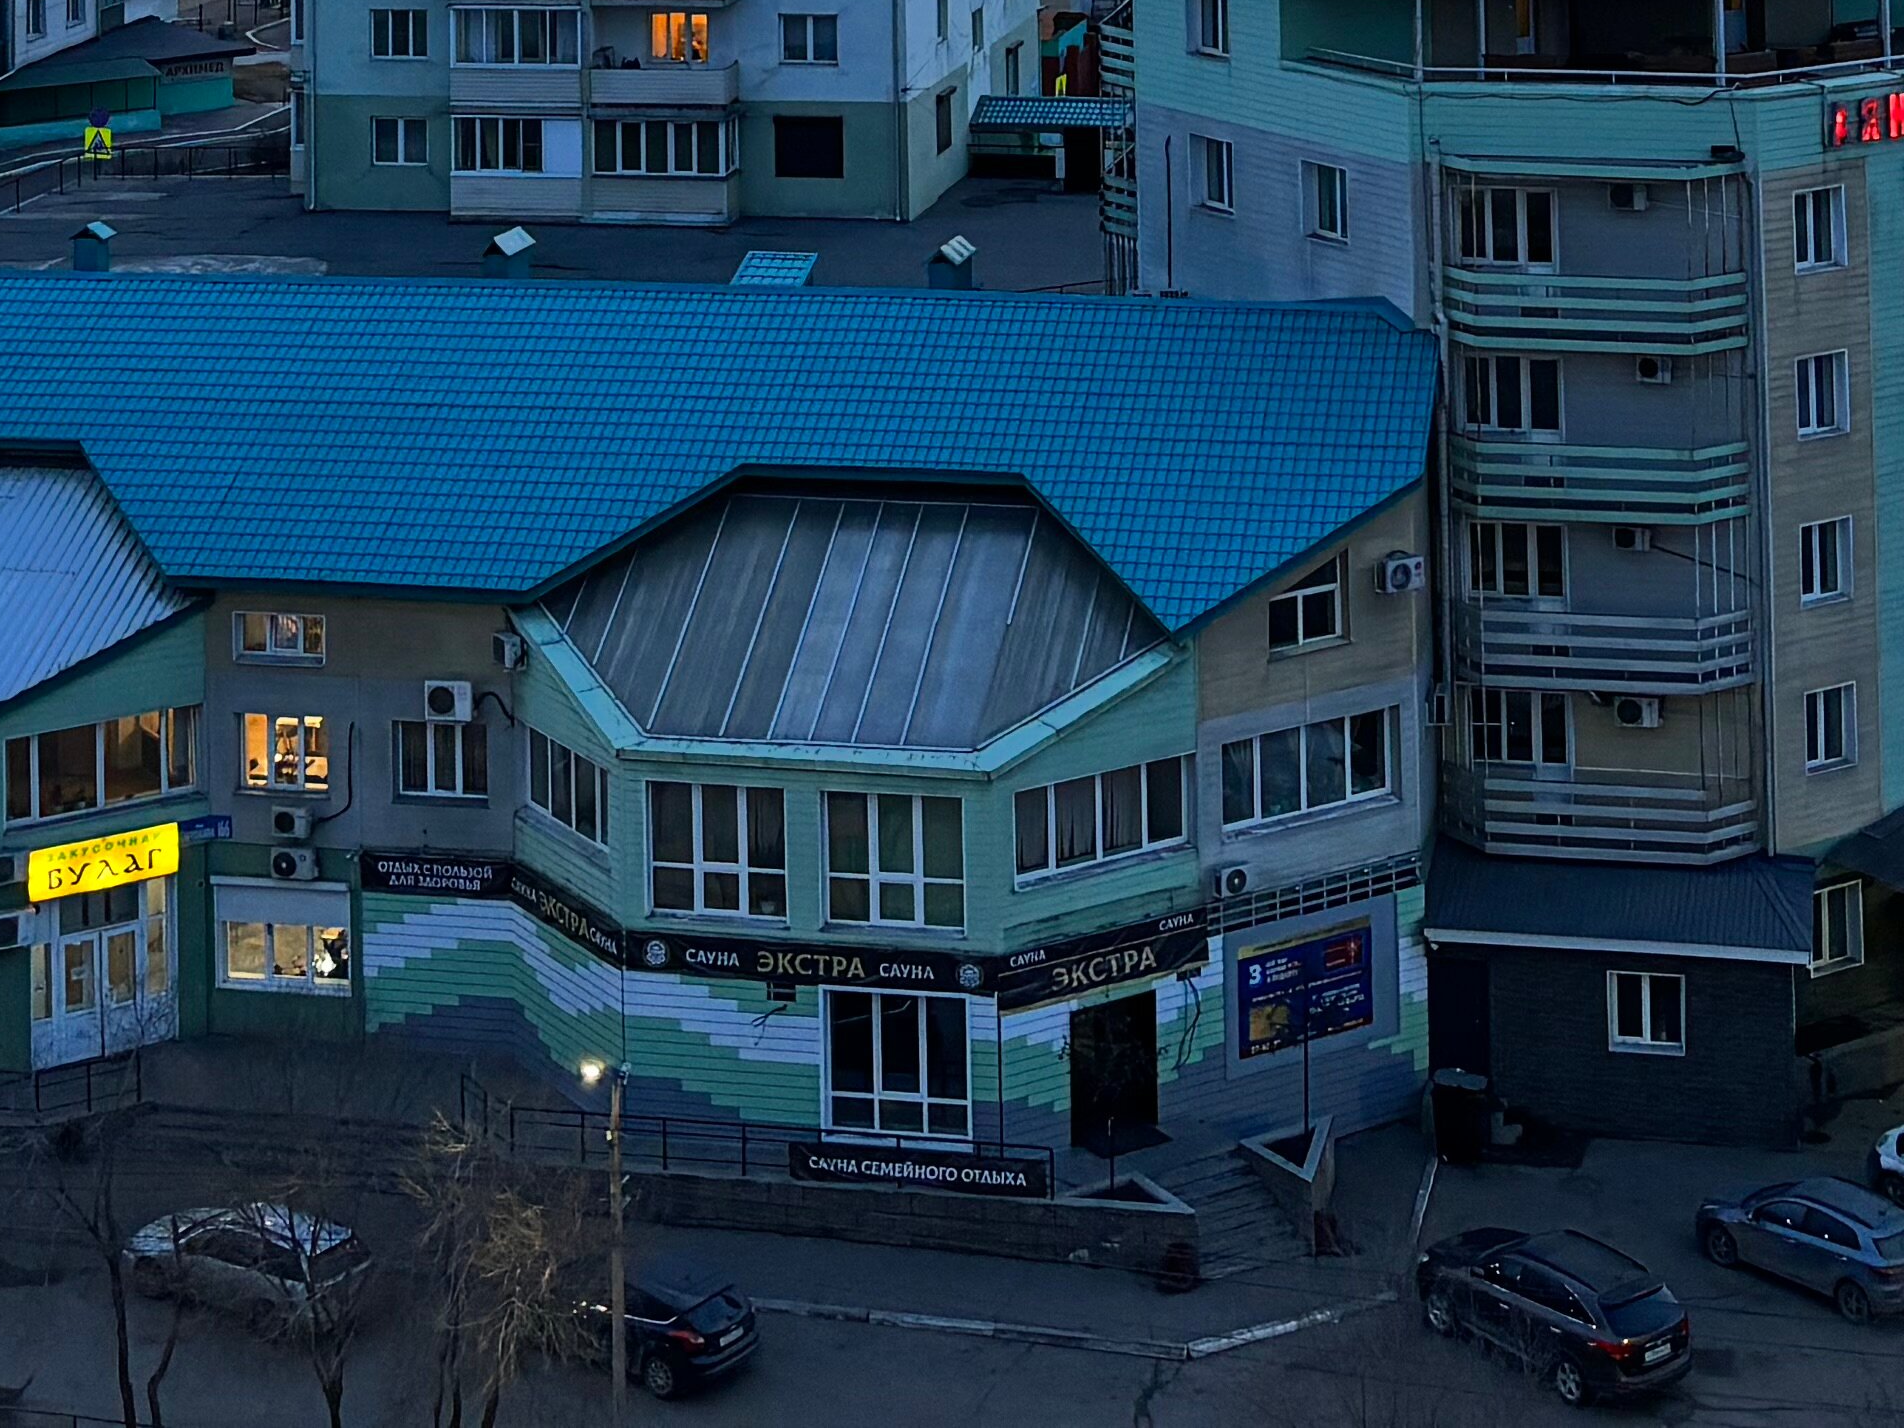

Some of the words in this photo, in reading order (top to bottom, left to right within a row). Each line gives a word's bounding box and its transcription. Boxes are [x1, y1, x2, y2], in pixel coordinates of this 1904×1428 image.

[377, 860, 421, 874] ОТДЫХ
[423, 863, 431, 875] С
[433, 863, 494, 880] ПОЛЬЗОЙ
[388, 874, 415, 887] ДЛЯ
[417, 875, 482, 891] ЗДОРОВЬЯ
[538, 890, 590, 941] ЭКСТРА
[1009, 948, 1046, 968] САУНА
[1158, 913, 1194, 931] САУНА
[685, 947, 740, 968] САУНА
[756, 950, 865, 979] ЭКСТРА
[879, 962, 935, 981] САУНА
[1051, 945, 1157, 992] ЭКСТРА
[808, 1155, 858, 1174] САУНА
[860, 1160, 958, 1182] СЕМЕЙНОГО
[960, 1167, 1027, 1187] ОТДЫХА
